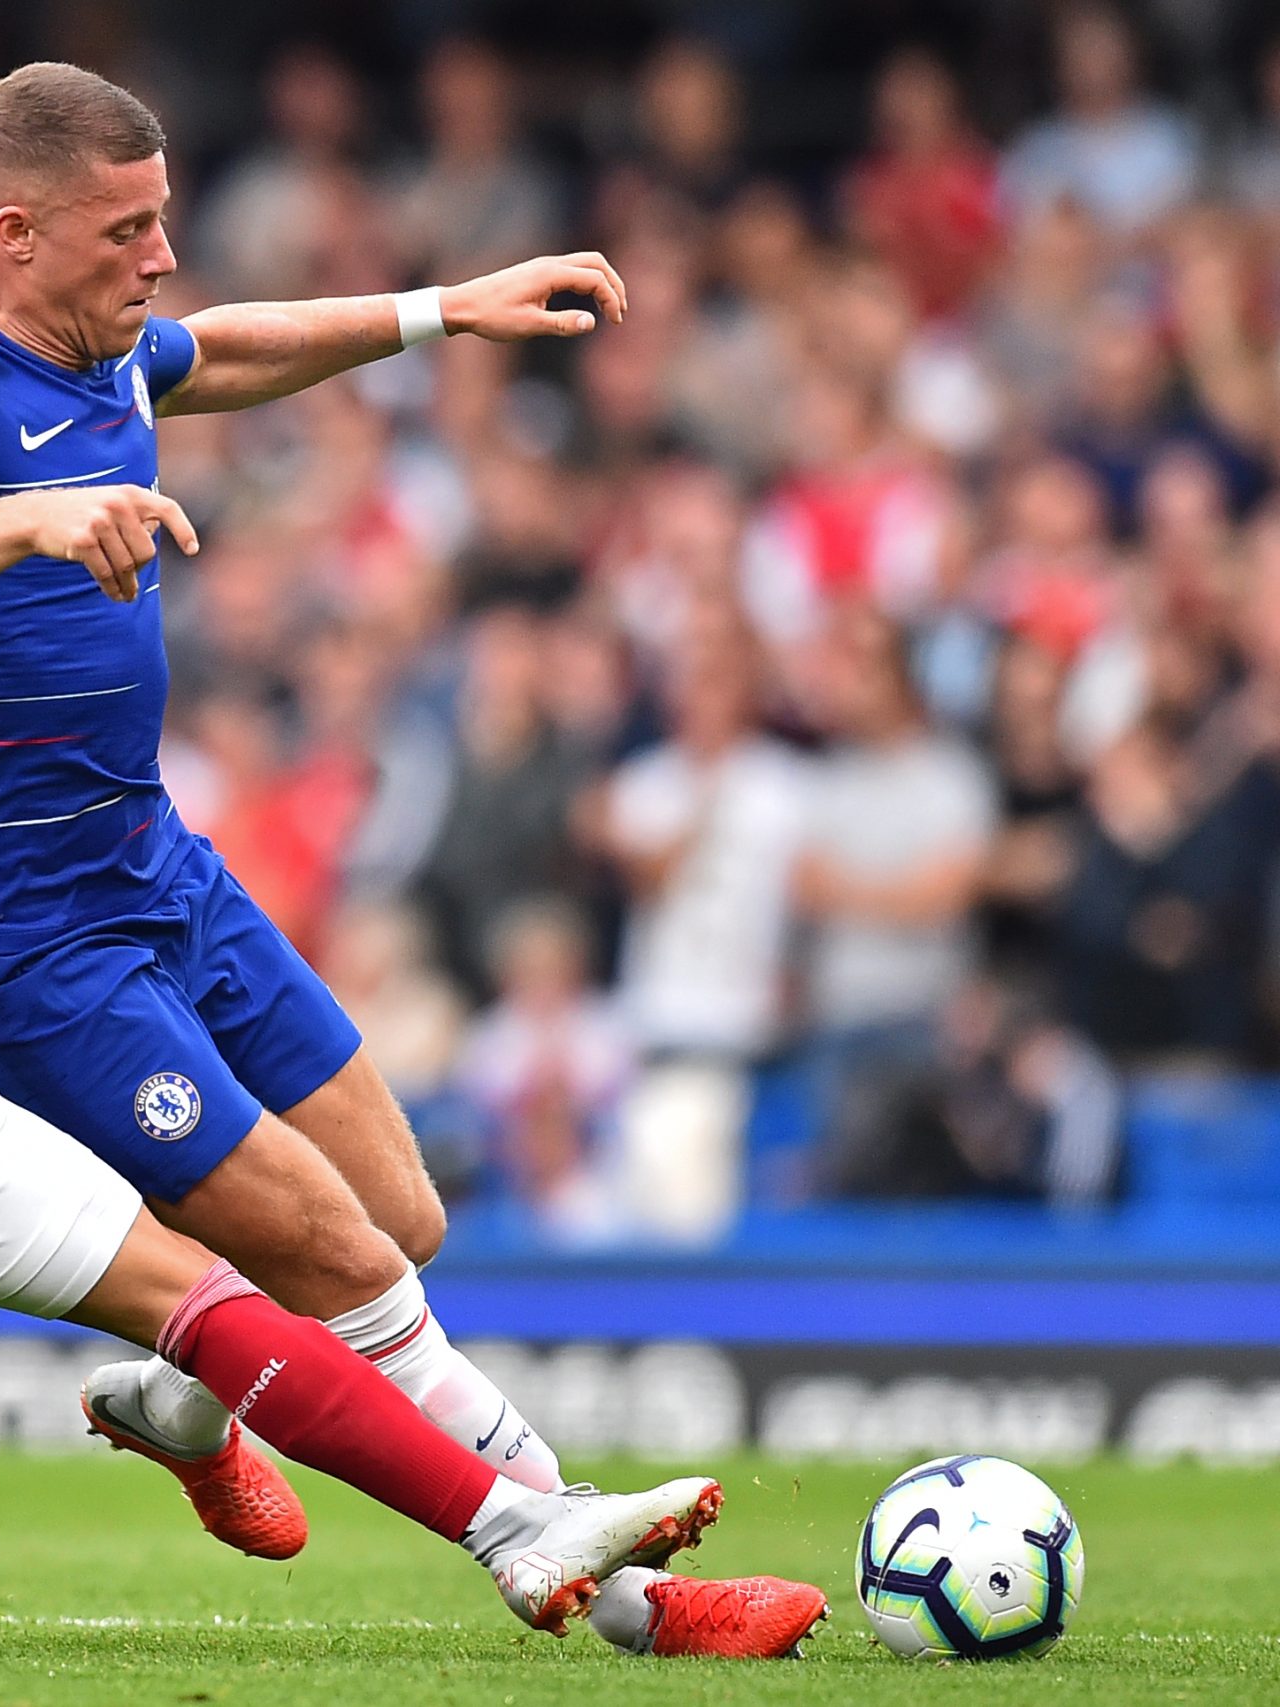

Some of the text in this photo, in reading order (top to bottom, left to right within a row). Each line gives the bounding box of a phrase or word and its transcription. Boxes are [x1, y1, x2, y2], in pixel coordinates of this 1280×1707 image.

[137, 1076, 166, 1112] CHELSEA
[234, 1357, 288, 1419] SENAL
[505, 1424, 531, 1461] CFC
